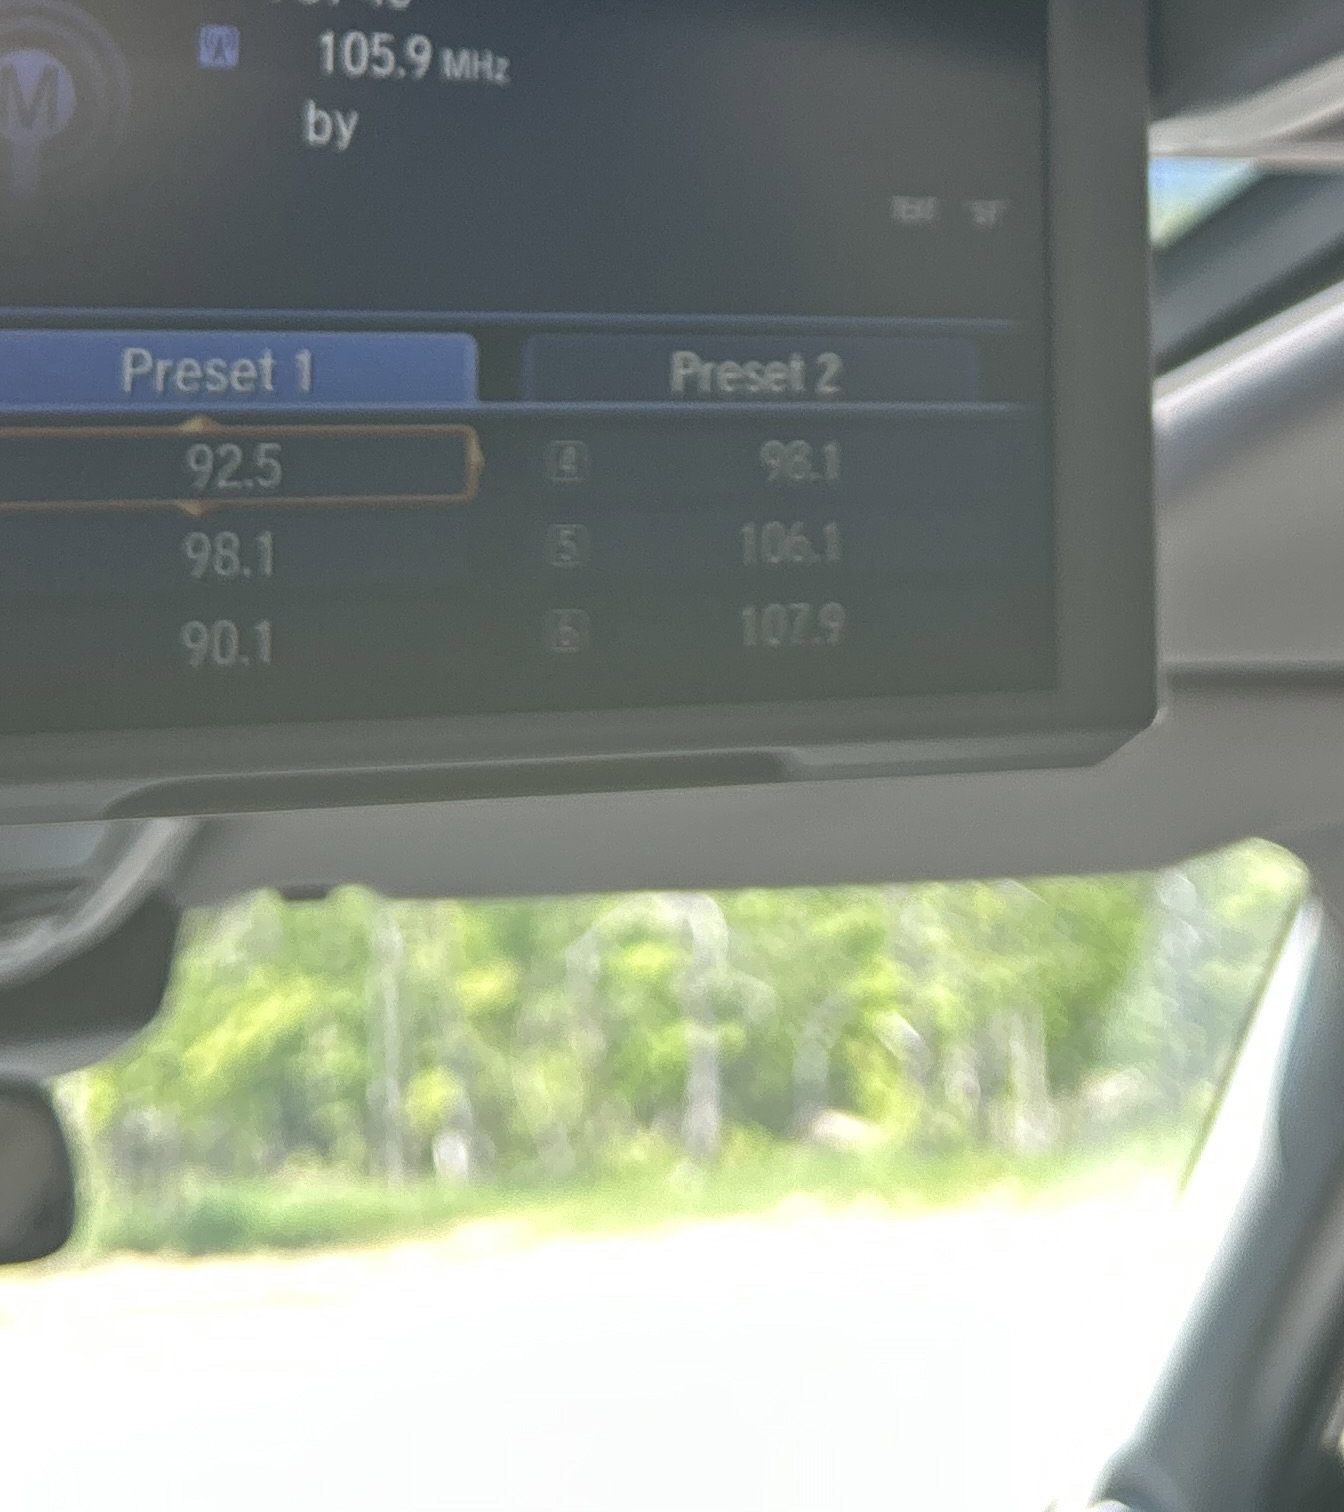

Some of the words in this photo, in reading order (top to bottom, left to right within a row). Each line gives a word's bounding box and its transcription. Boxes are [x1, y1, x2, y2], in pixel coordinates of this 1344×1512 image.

[318, 30, 432, 79] 105.9
[302, 98, 358, 152] by
[120, 346, 277, 394] Preset
[295, 348, 313, 393] 1
[669, 349, 804, 393] Preset
[816, 352, 844, 393] 2
[186, 442, 283, 490] 92.5
[759, 438, 843, 486] 98.1
[184, 531, 274, 578] 98.1
[740, 520, 843, 567] 106.1
[180, 620, 273, 668] 90.1
[740, 601, 847, 648] 107.9
